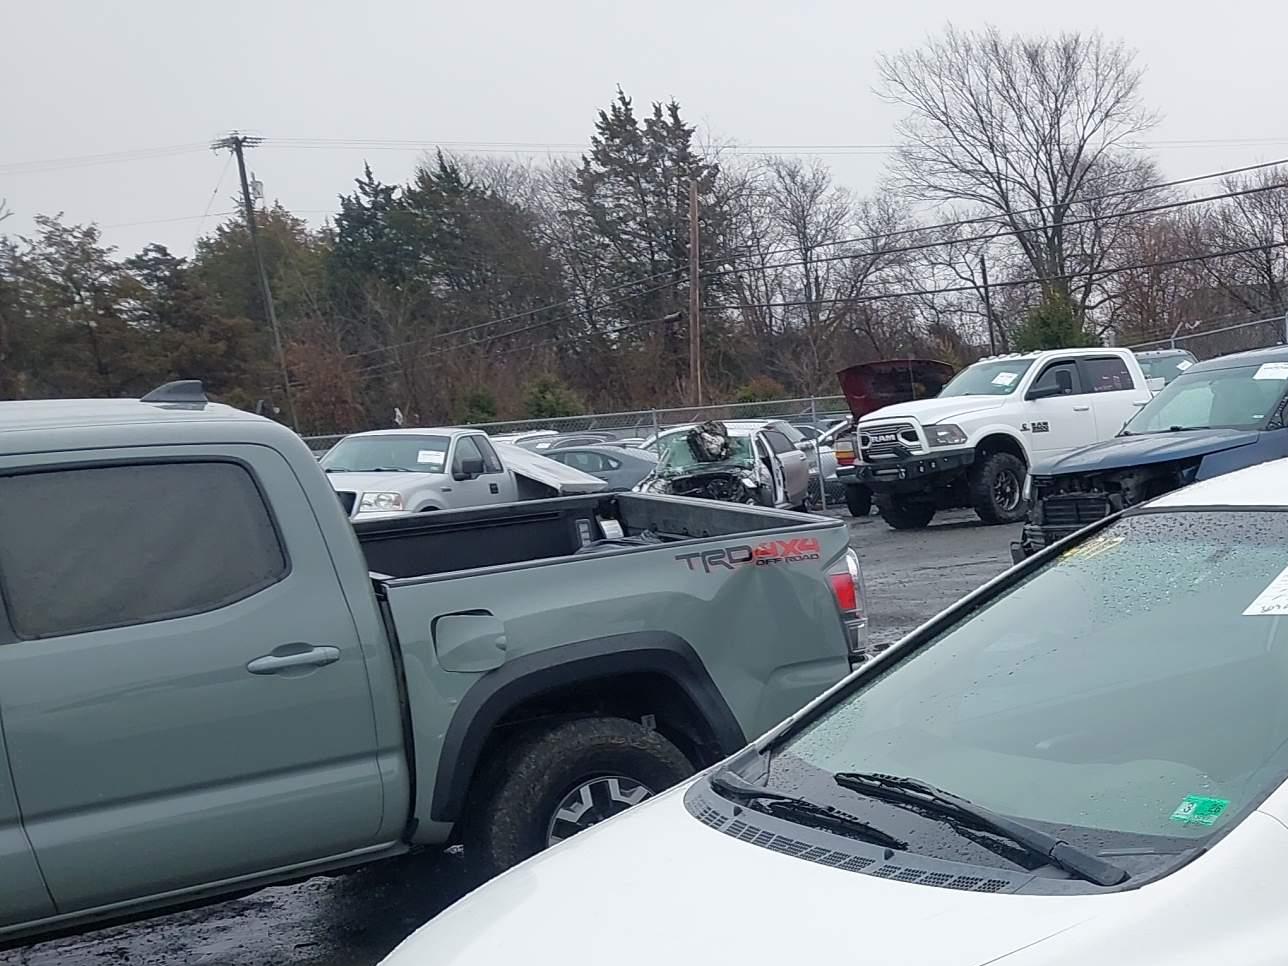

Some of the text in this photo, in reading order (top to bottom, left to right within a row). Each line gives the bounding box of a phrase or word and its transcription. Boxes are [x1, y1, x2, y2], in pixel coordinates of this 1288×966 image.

[871, 434, 897, 443] RAM
[674, 545, 753, 573] TRD
[756, 553, 820, 566] OFF ROAD
